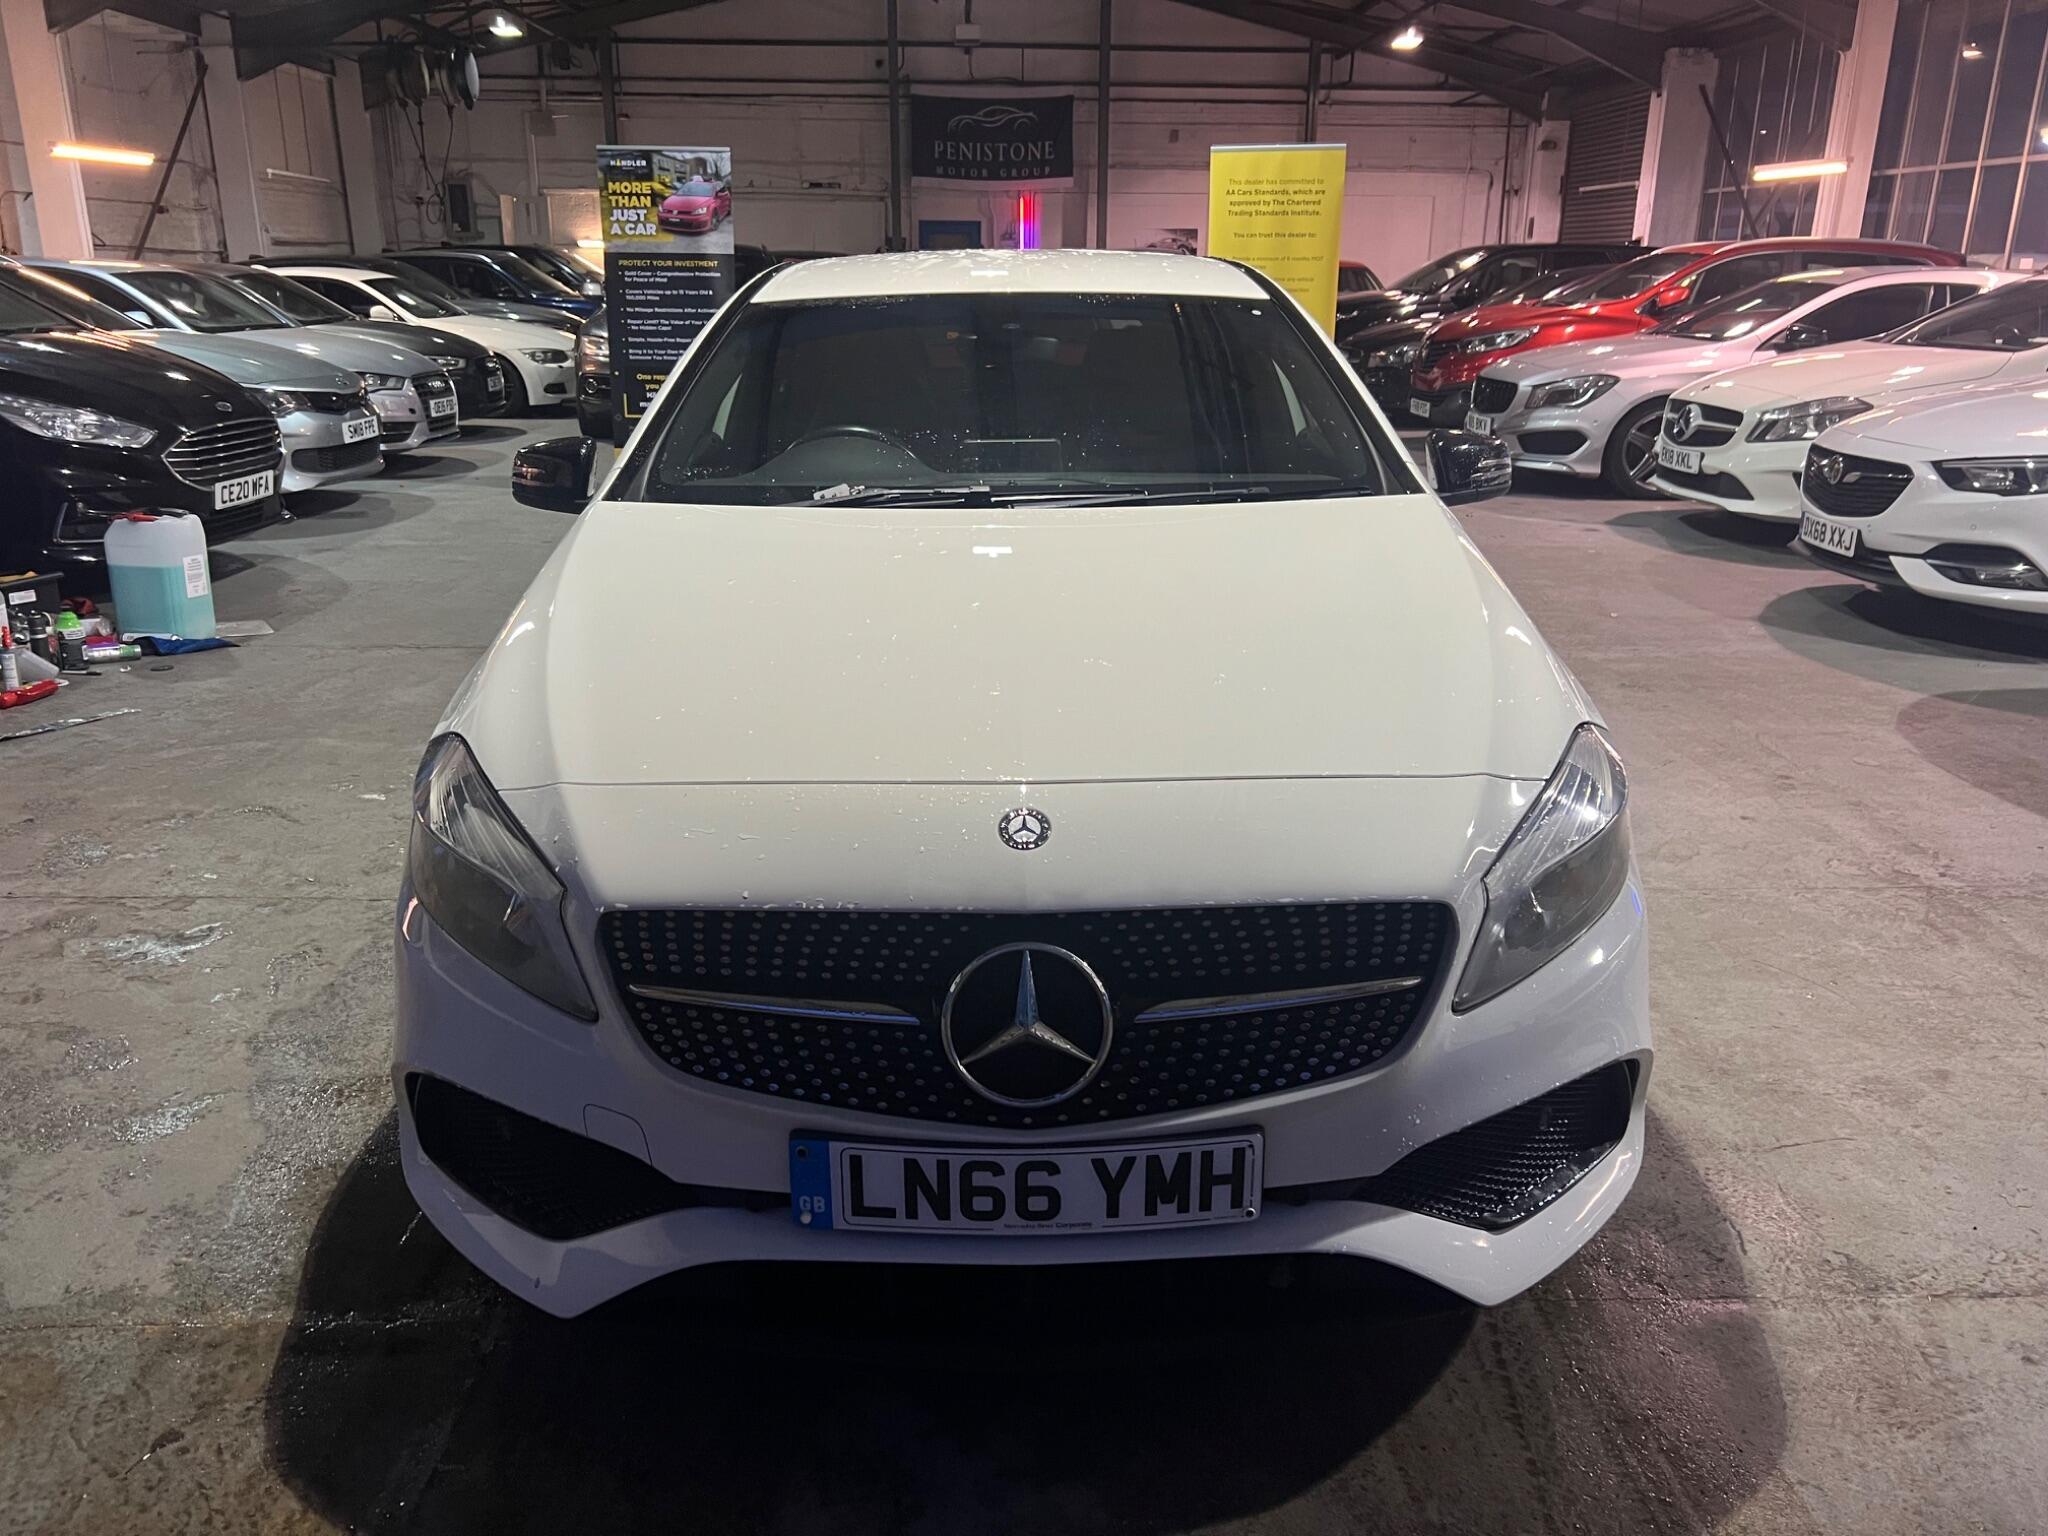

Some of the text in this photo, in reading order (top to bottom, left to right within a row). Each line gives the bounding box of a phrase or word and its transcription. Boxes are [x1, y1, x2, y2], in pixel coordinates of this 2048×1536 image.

[934, 140, 1055, 162] PENISTONE
[936, 166, 1051, 178] MOTOR GROUP
[608, 181, 652, 194] MORE
[608, 195, 652, 208] THAN
[610, 209, 647, 222] JUST
[1228, 210, 1253, 218] Trading
[610, 223, 657, 235] A CAR
[674, 260, 719, 268] INVESTMENT
[348, 418, 376, 440] SM18 FPE
[1674, 450, 1693, 470] XKL
[220, 472, 270, 505] CE20 WFA
[1803, 516, 1854, 551] DX68 XXJ
[848, 1146, 1247, 1223] LN66 YMH
[798, 1194, 826, 1215] GB
